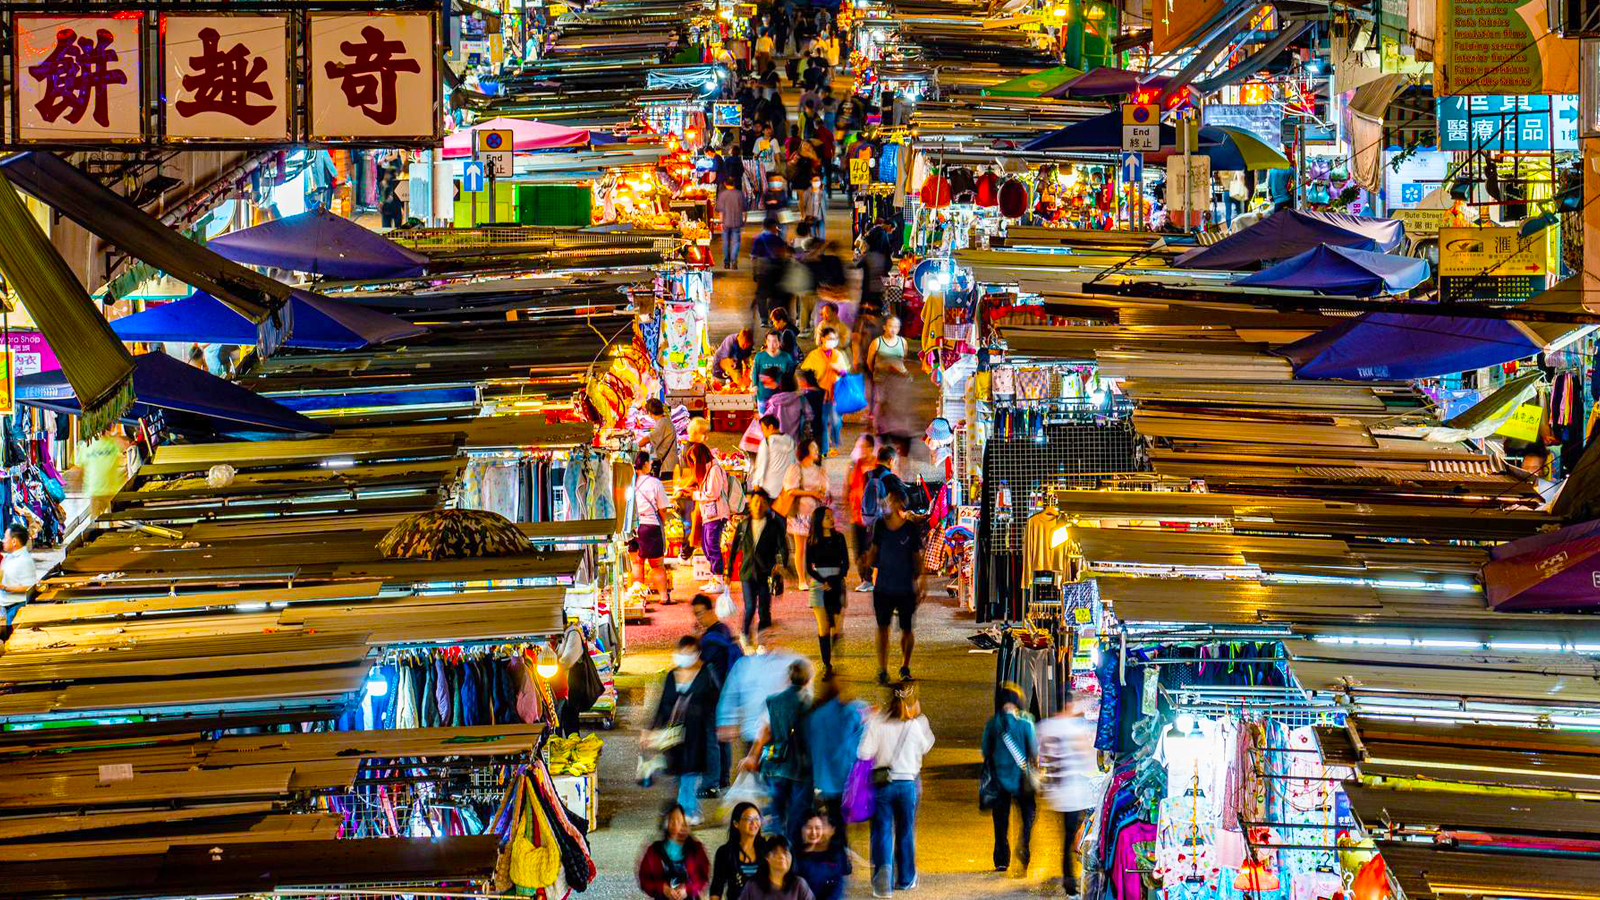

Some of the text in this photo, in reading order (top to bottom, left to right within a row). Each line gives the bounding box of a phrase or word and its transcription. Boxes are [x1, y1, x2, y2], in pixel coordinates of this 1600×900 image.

[1133, 128, 1150, 136] End
[852, 160, 868, 173] 40
[21, 335, 41, 345] Shop
